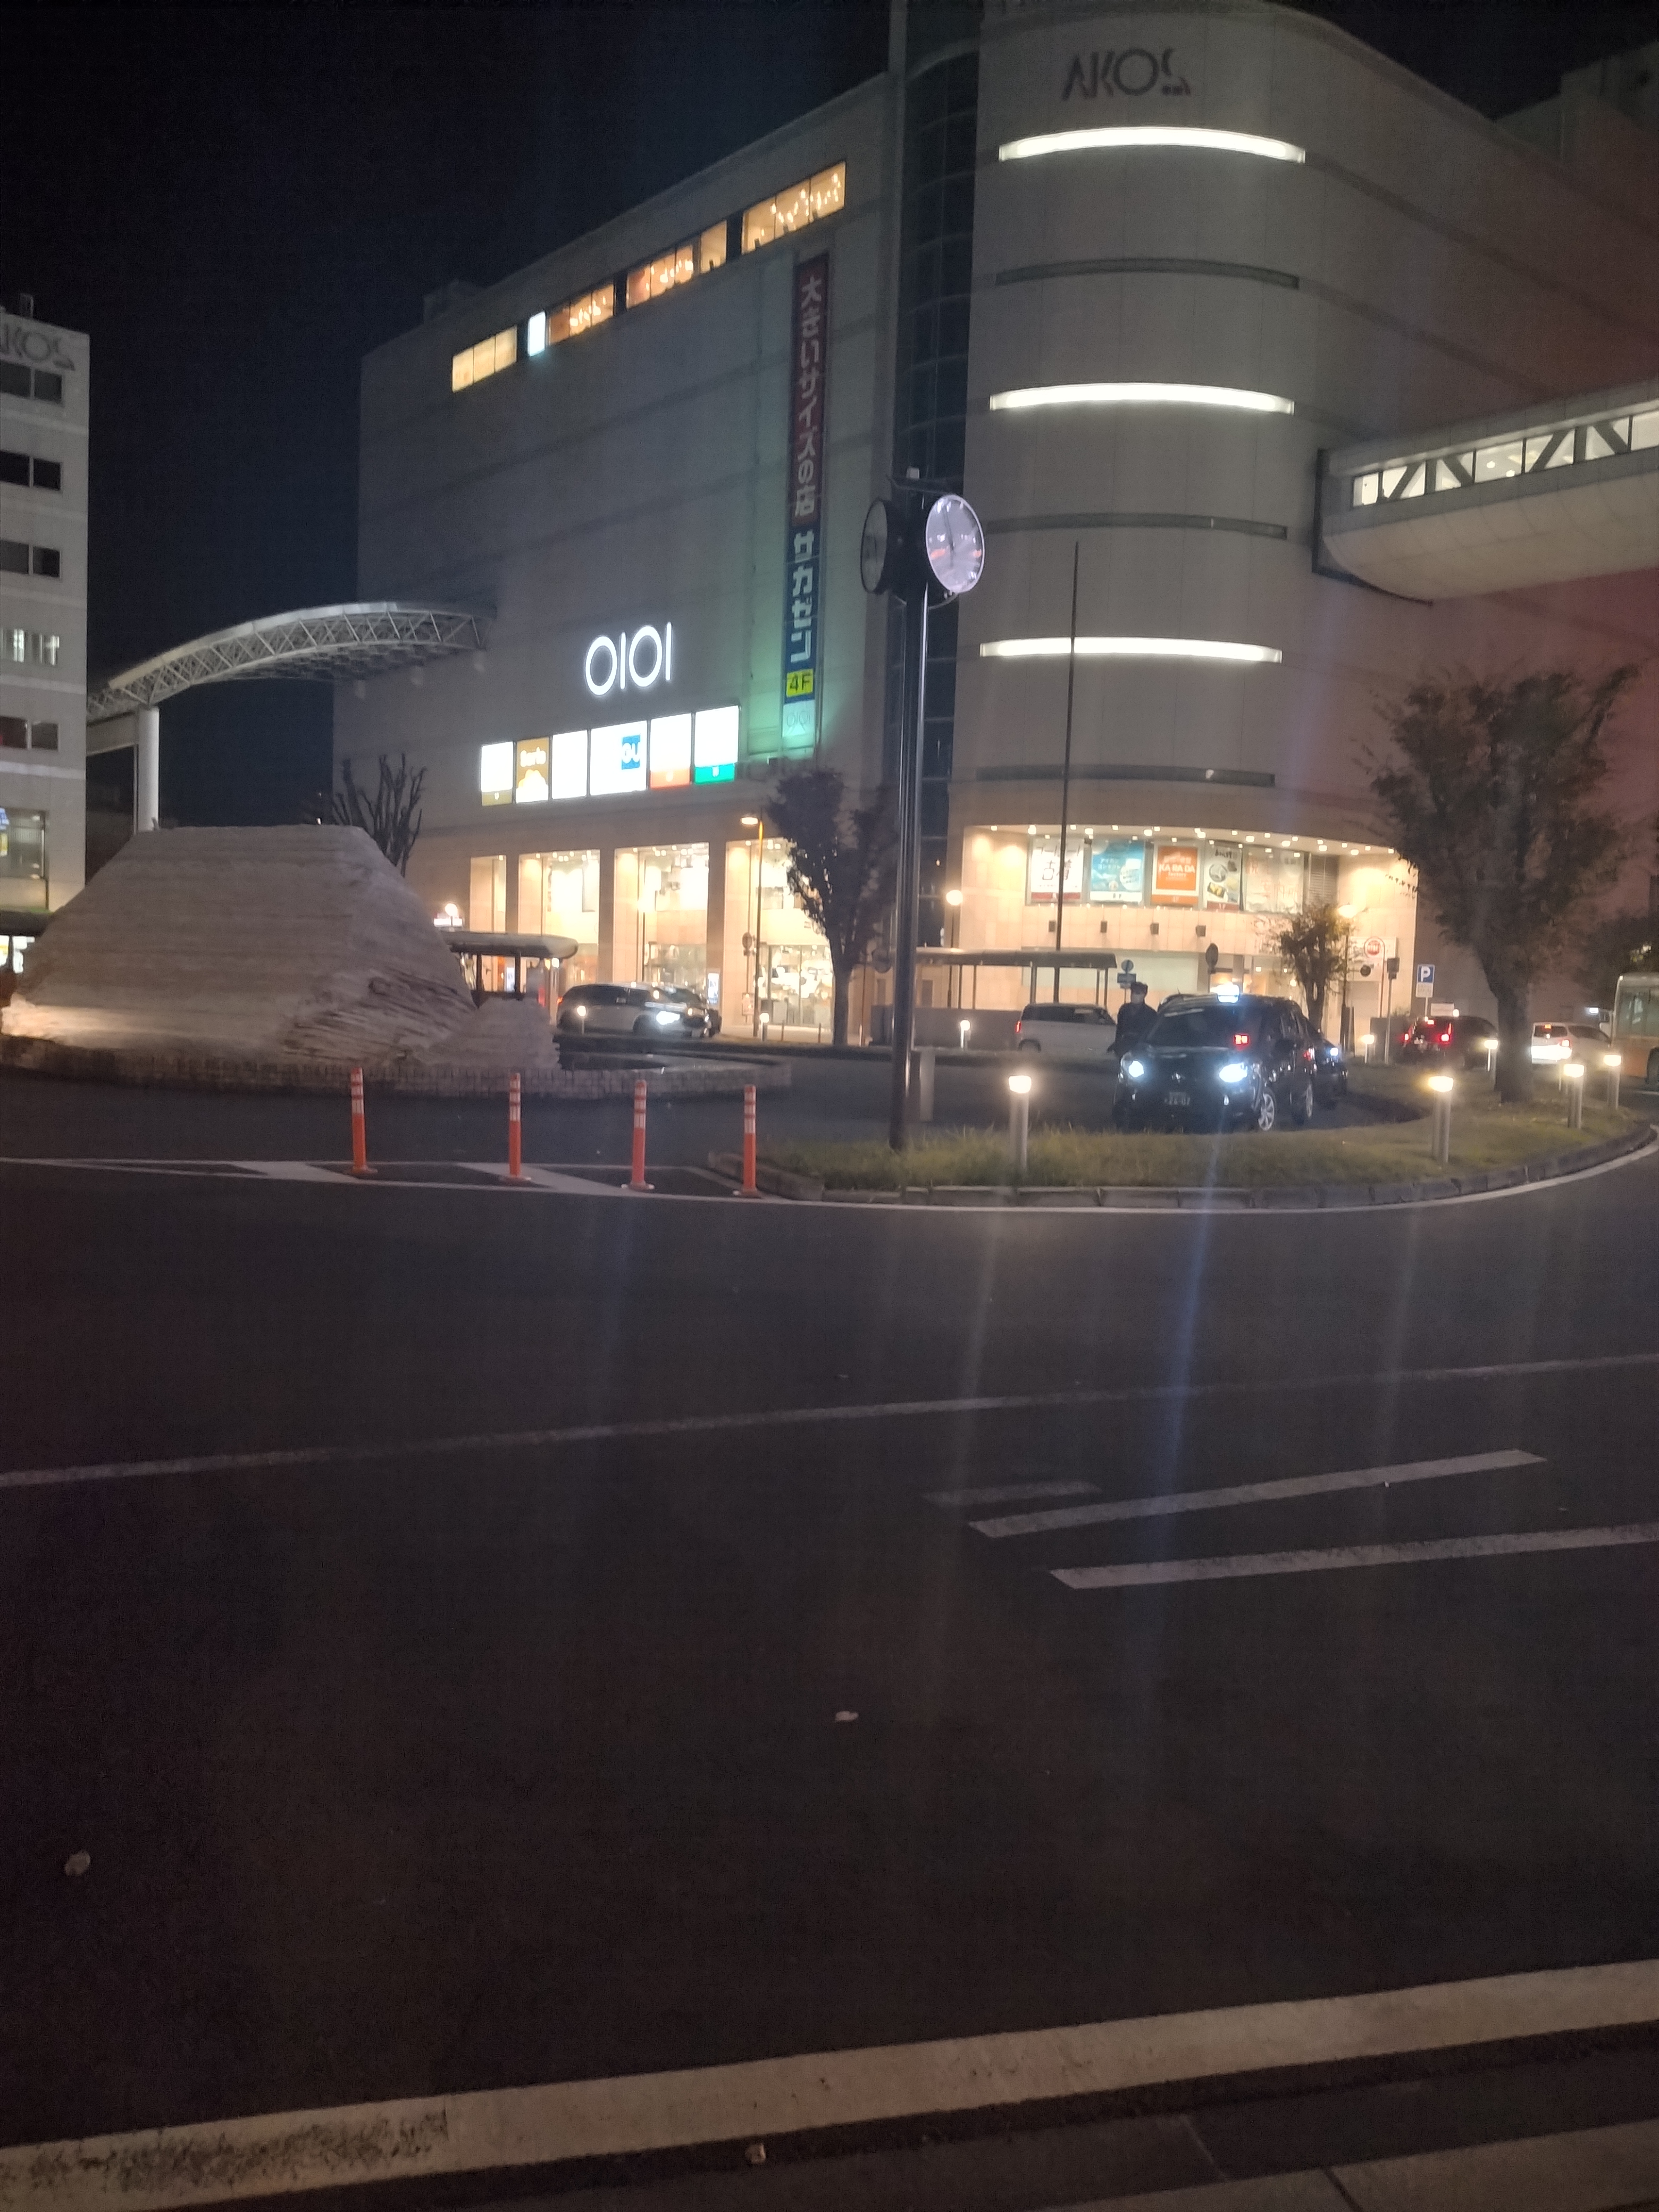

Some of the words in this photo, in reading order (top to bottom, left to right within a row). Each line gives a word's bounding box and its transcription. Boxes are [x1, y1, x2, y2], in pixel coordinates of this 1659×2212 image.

[794, 276, 823, 517] 大きいサイズの店
[790, 673, 811, 692] 4F
[622, 742, 641, 764] GU
[1420, 966, 1431, 982] P
